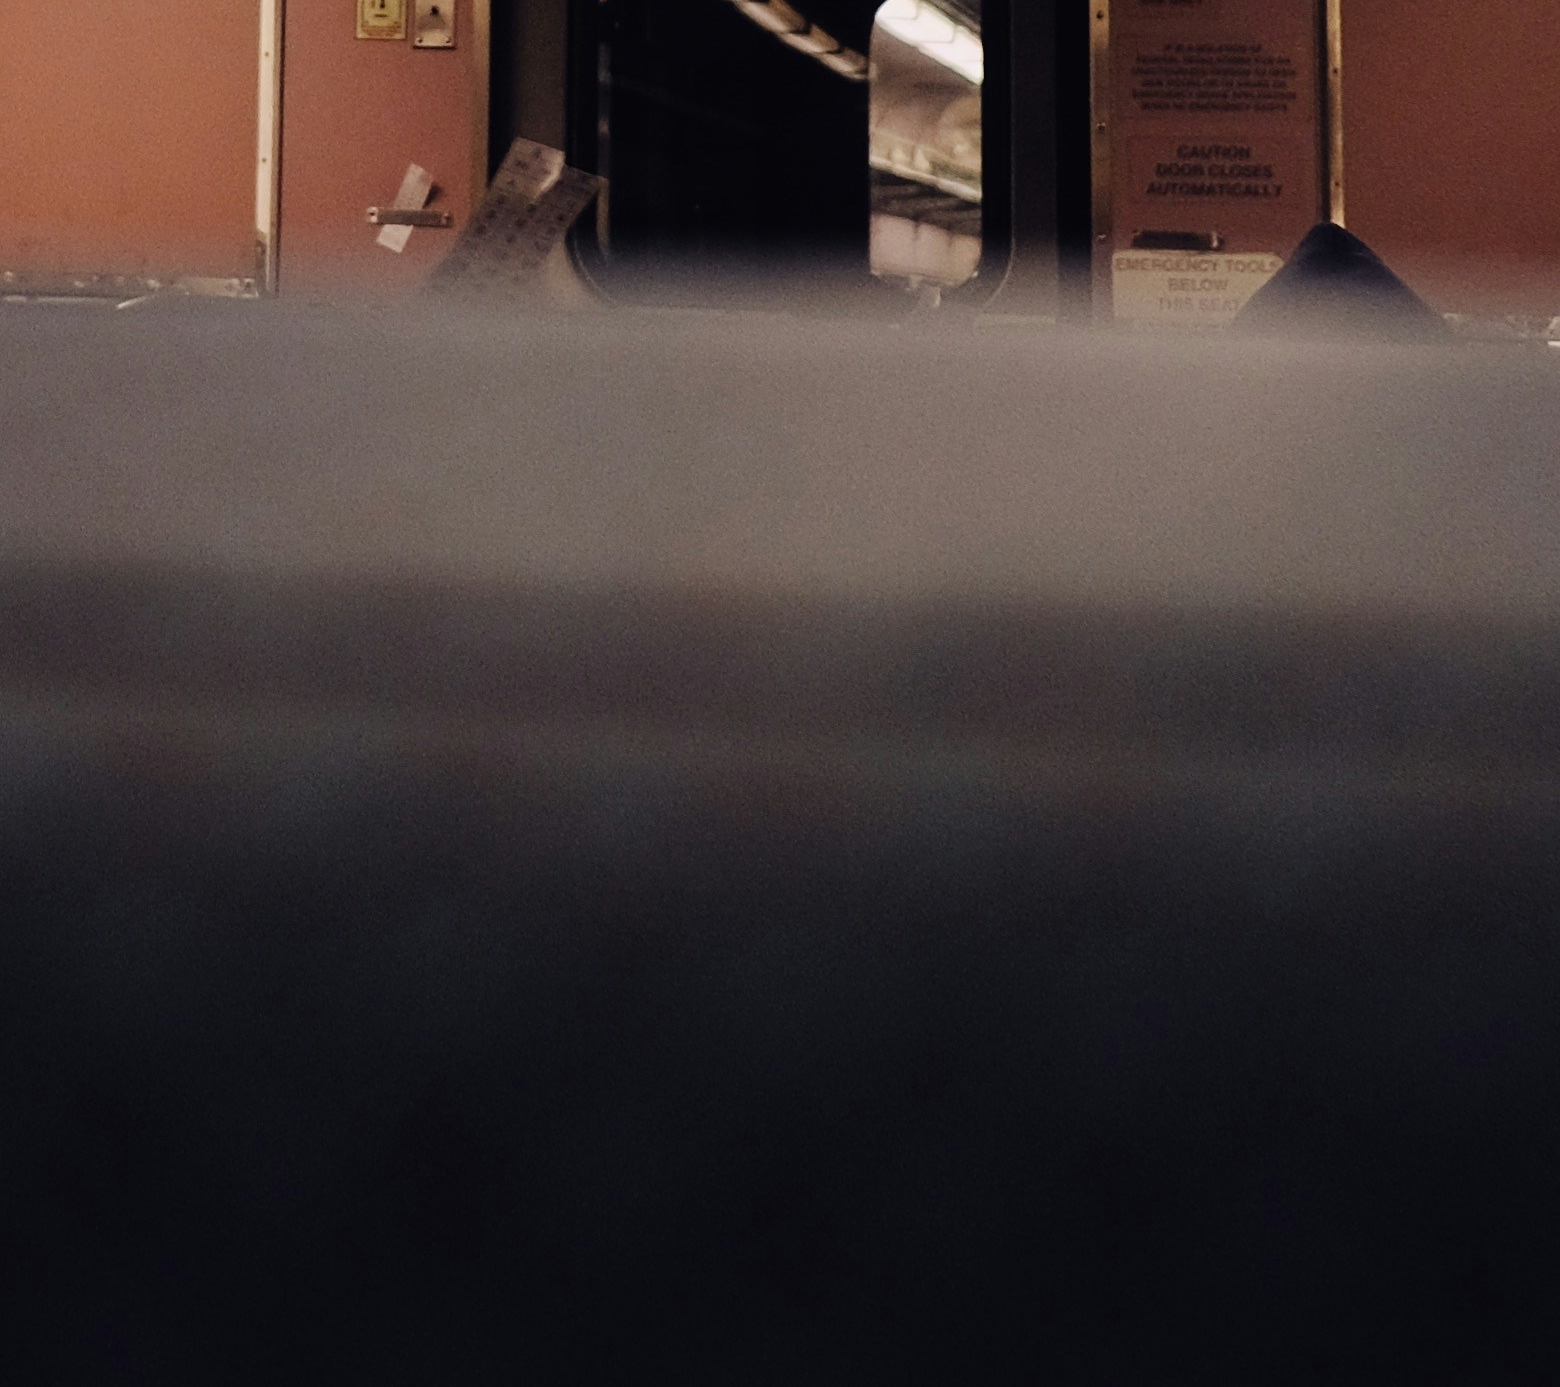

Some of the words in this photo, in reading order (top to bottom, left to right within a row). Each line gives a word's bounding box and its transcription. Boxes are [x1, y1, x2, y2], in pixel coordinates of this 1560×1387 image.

[1177, 144, 1251, 159] CAUTION
[1155, 163, 1205, 177] DOOR
[1208, 164, 1273, 178] CLOSES
[1146, 182, 1283, 197] AUTOMATICALLY
[1115, 258, 1218, 272] EMERGENCY
[1168, 277, 1228, 292] BELOW
